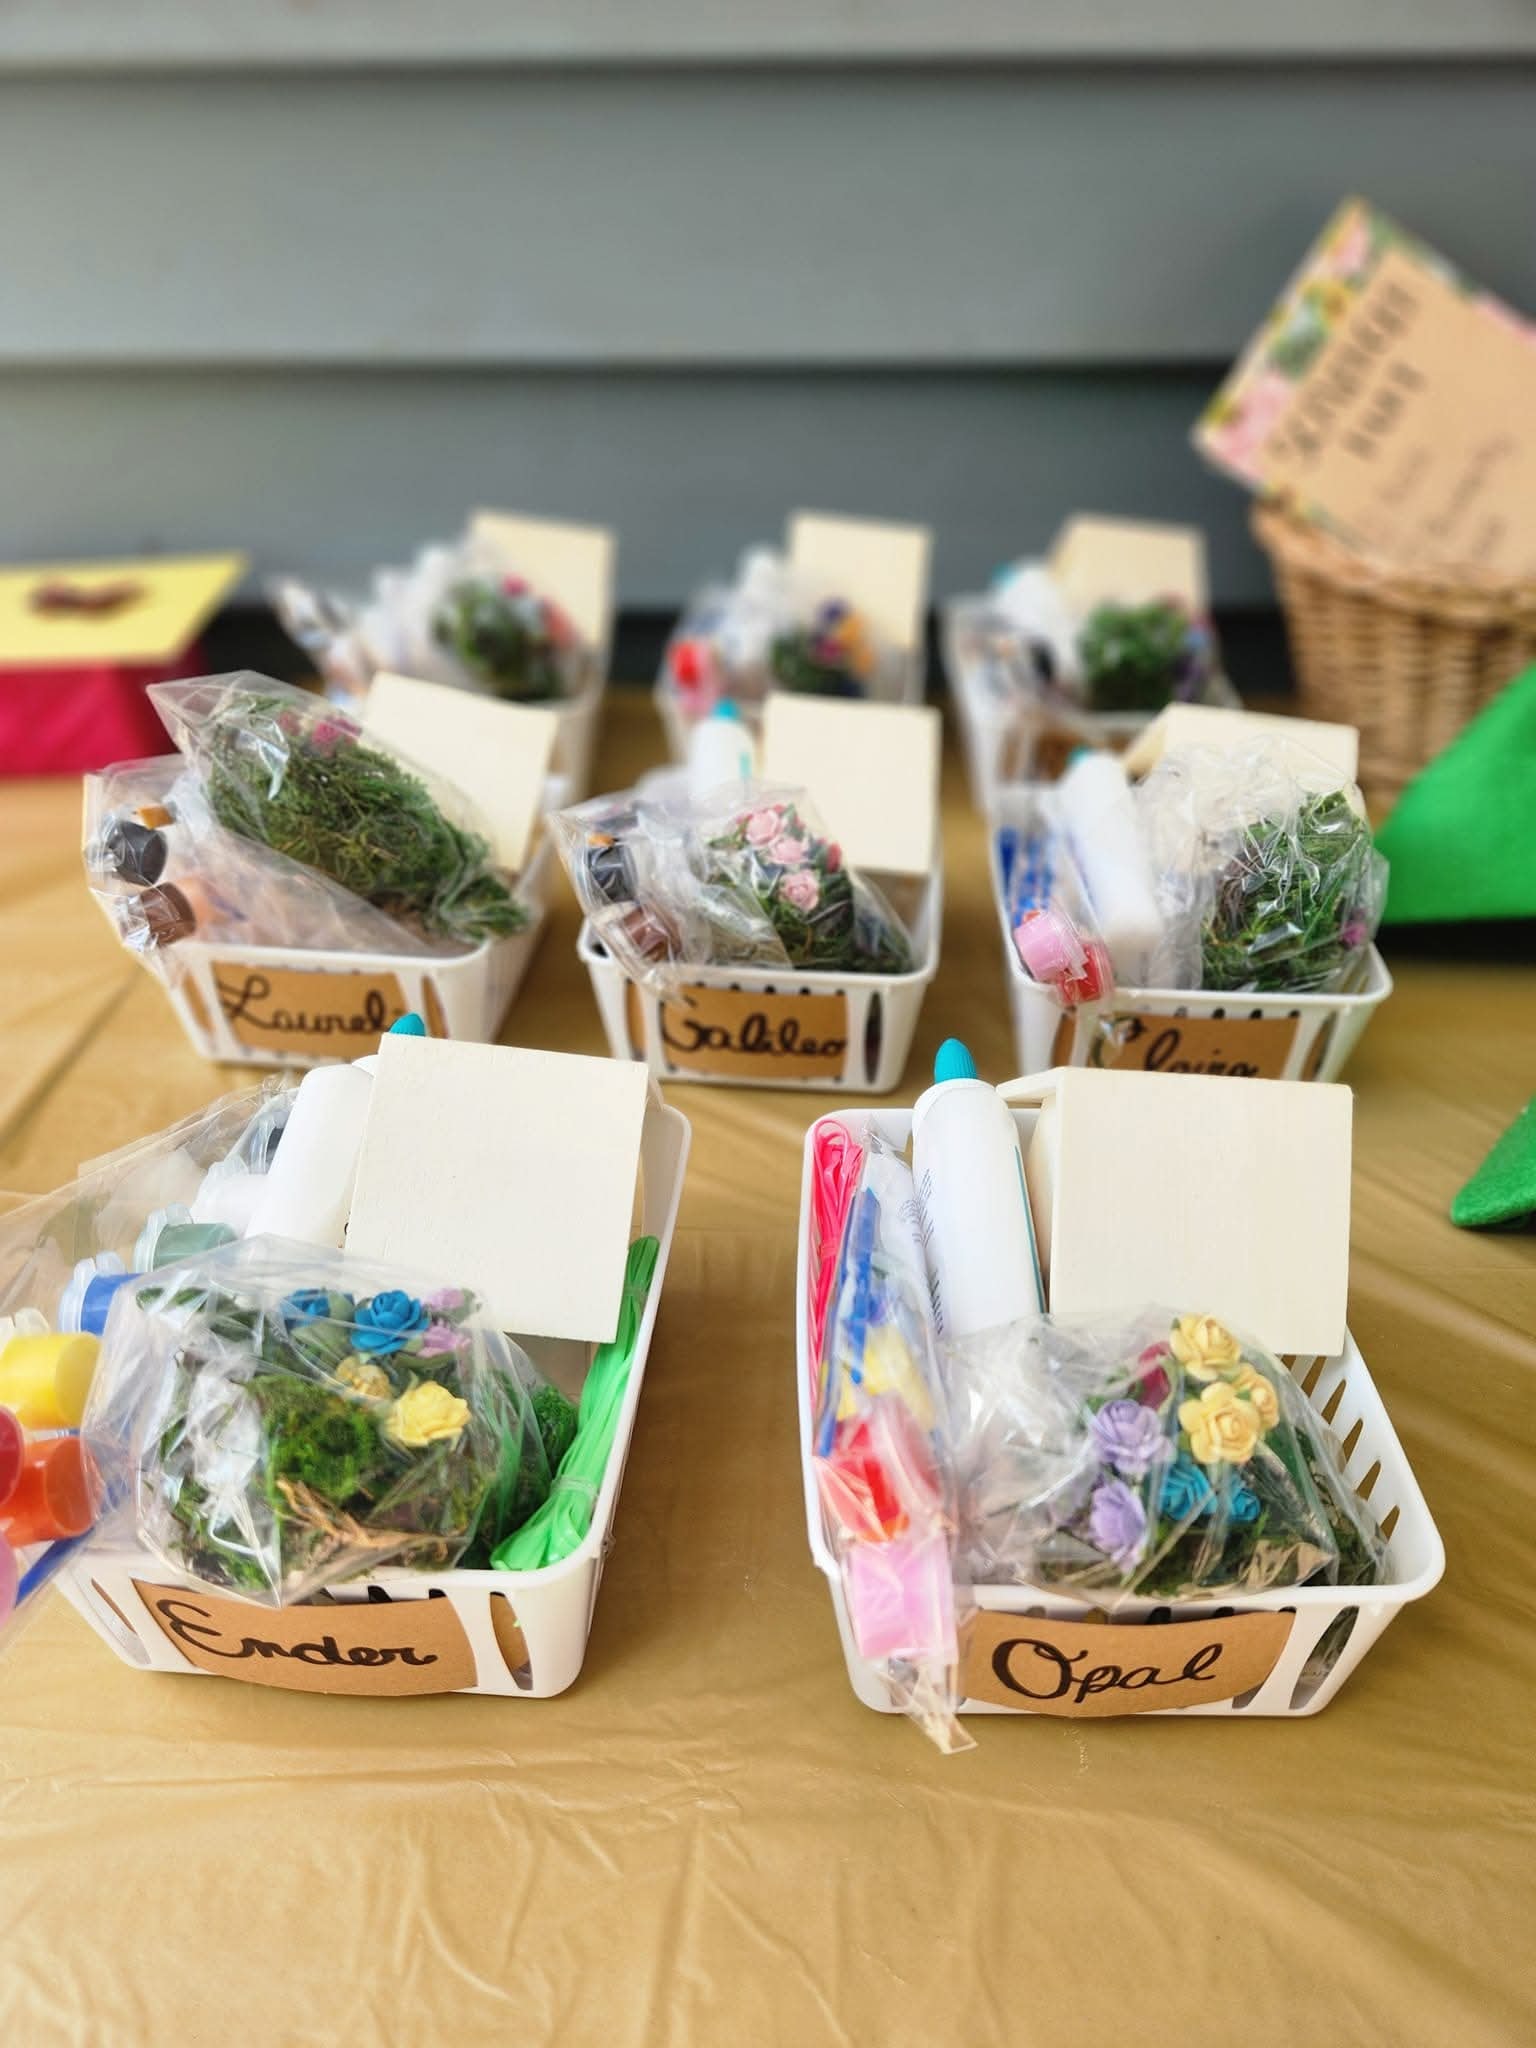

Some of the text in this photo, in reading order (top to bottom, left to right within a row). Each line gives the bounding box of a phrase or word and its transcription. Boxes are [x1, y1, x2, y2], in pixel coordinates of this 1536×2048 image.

[217, 974, 402, 1036] Laurel
[156, 1599, 438, 1667] Ender
[991, 1638, 1224, 1703] Opal
